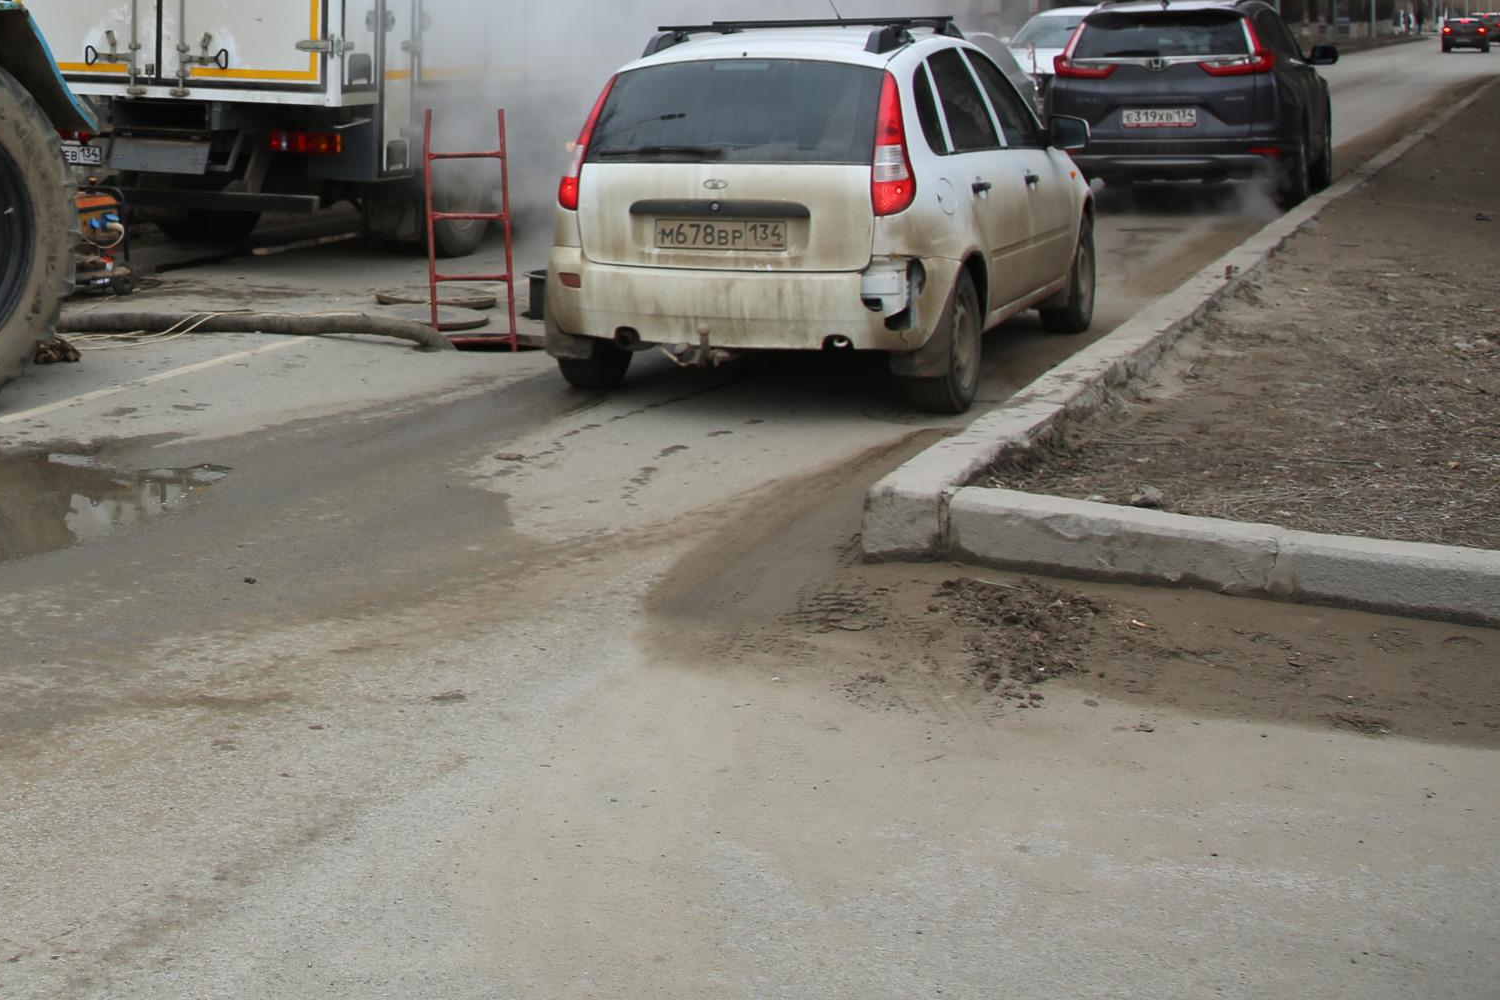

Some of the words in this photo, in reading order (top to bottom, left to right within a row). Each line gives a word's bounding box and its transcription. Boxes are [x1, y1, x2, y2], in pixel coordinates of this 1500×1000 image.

[81, 147, 99, 159] 134
[660, 223, 743, 246] М678ВР
[749, 223, 783, 242] 134
